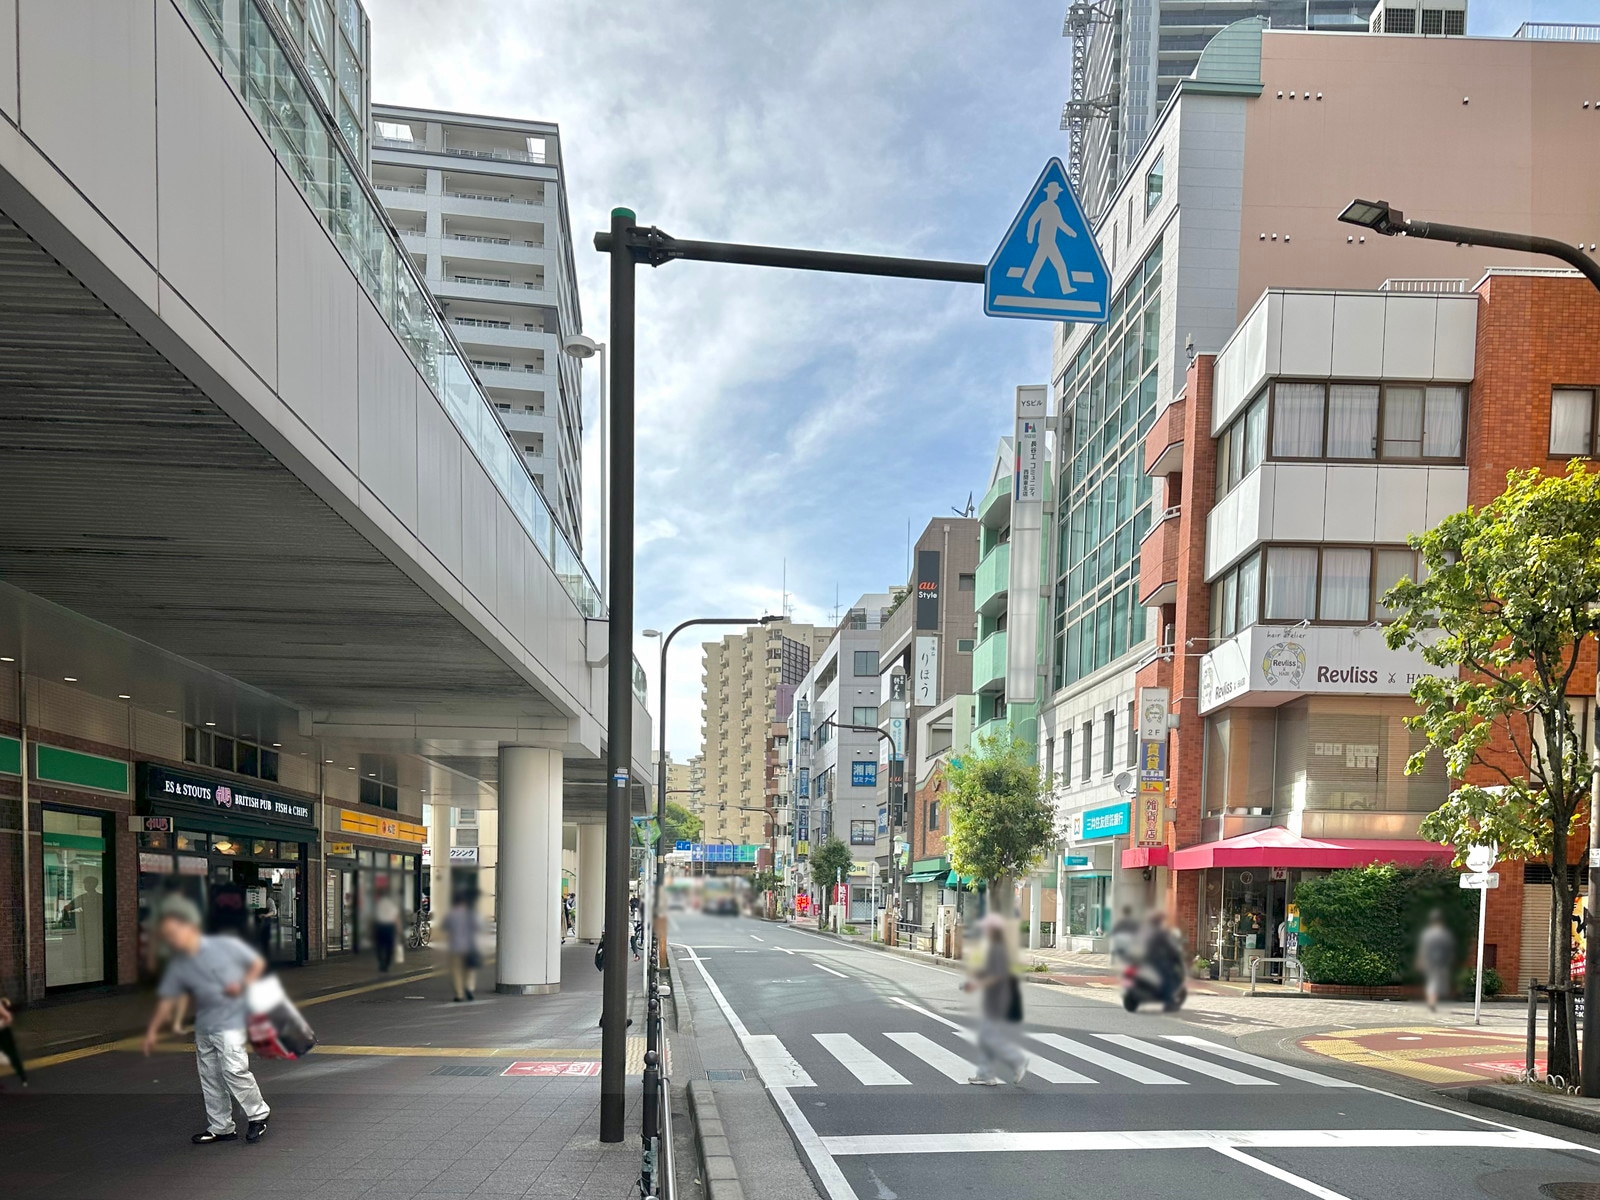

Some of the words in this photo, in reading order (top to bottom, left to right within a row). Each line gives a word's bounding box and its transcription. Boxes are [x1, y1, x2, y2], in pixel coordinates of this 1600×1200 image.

[918, 581, 938, 590] au
[918, 591, 938, 599] Style
[1272, 659, 1297, 667] Revliss
[1317, 665, 1378, 684] Revliss
[853, 764, 876, 776] 湘南
[176, 783, 182, 794] &
[183, 784, 211, 800] STOUTS
[215, 785, 232, 808] HUB
[234, 794, 259, 808] BRITISH
[260, 798, 272, 810] PUB
[275, 801, 287, 814] FISH
[288, 804, 293, 815] &
[293, 805, 308, 818] CHIPS
[145, 817, 169, 831] HUB
